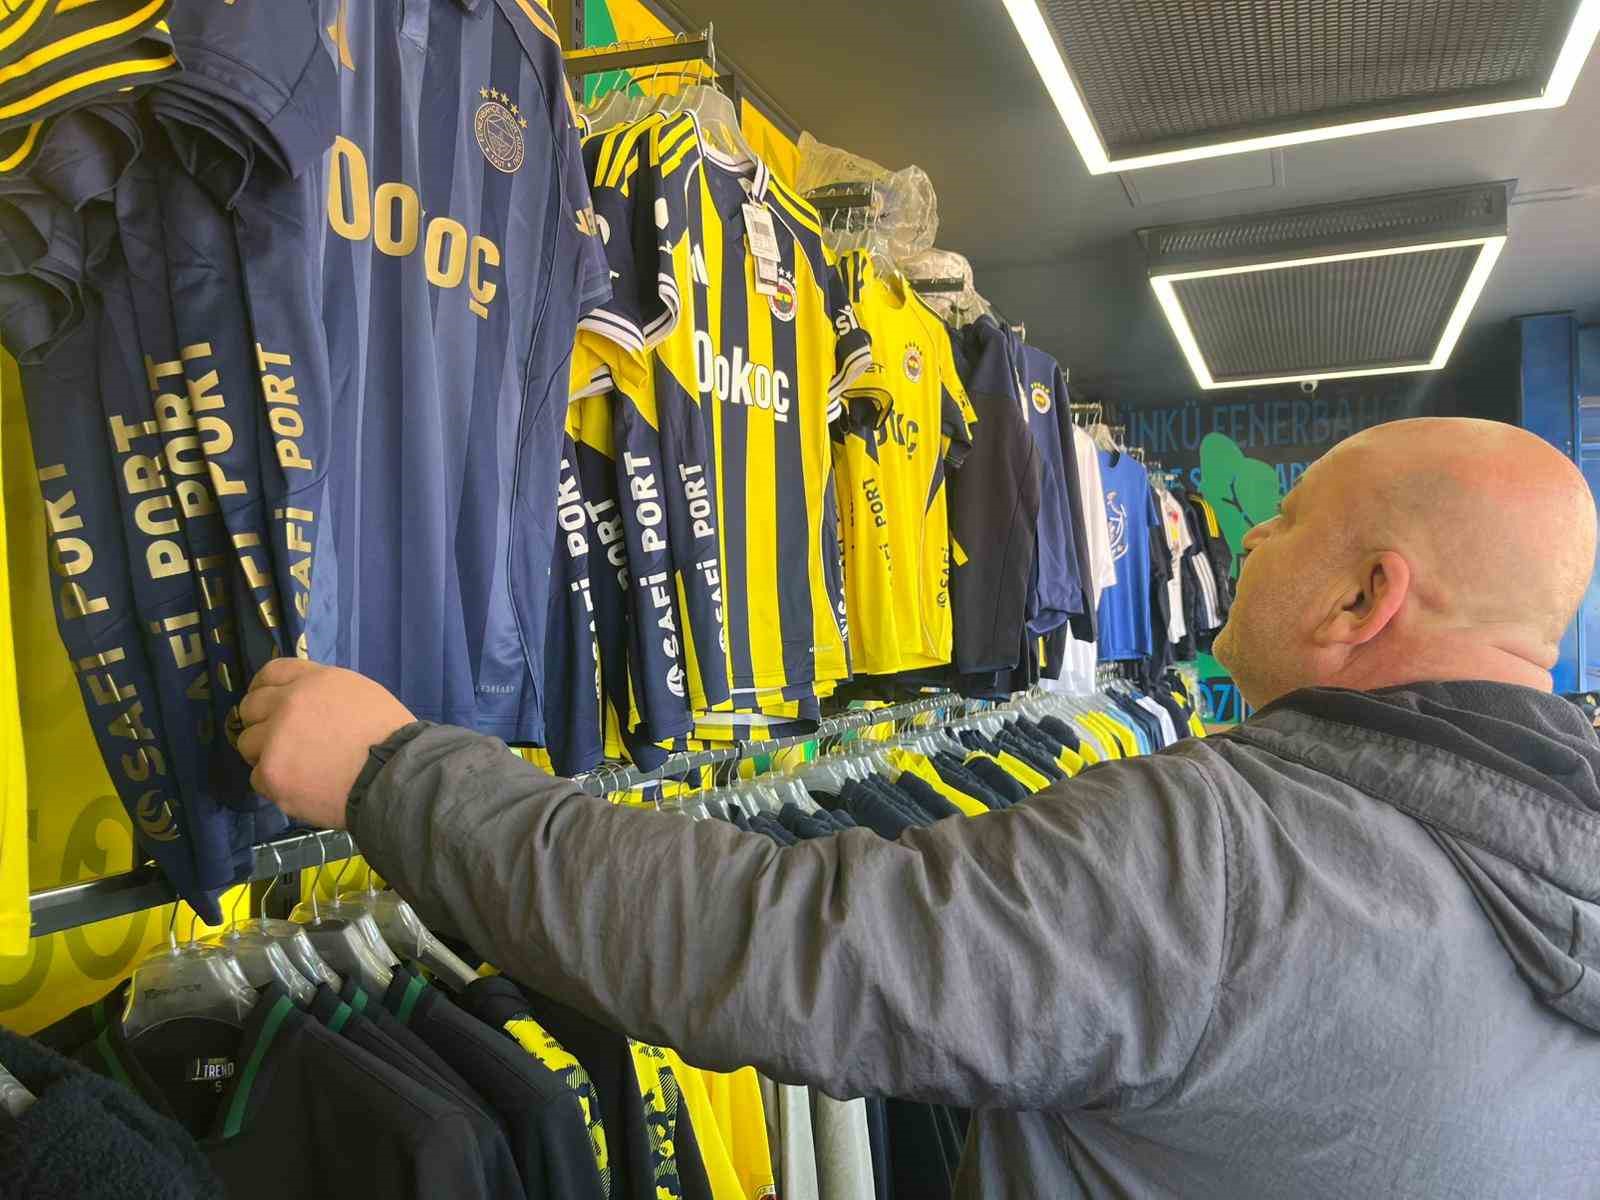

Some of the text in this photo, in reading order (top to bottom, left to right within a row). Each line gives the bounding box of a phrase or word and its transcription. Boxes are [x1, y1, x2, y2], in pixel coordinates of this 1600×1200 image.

[256, 342, 313, 471] PORT
[623, 451, 667, 554] PORT
[678, 463, 715, 539] PORT
